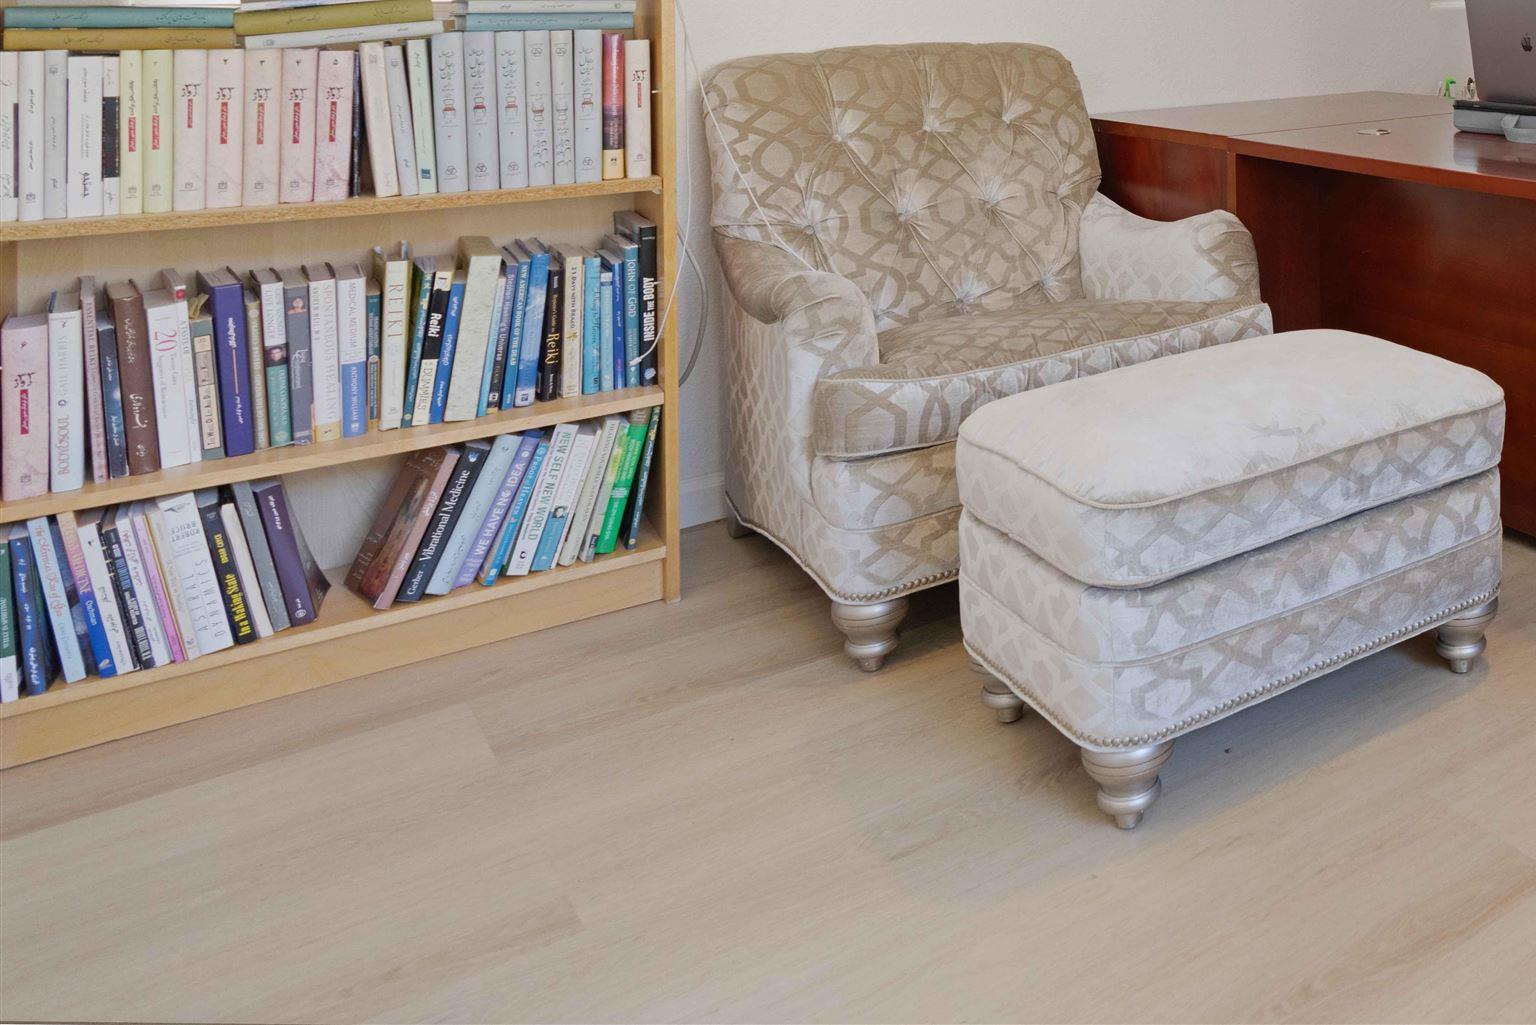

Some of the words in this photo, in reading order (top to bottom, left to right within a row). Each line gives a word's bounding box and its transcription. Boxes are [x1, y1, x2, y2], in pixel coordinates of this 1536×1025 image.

[501, 273, 515, 300] Stephen
[643, 277, 655, 299] BODY
[387, 283, 404, 339] REIKI
[498, 301, 511, 333] Hawking's
[627, 297, 637, 318] GOD
[428, 312, 440, 338] Reiki
[643, 309, 655, 341] INSIDE
[153, 330, 178, 352] 20
[495, 333, 507, 361] Universe
[556, 429, 573, 454] NEW
[547, 452, 565, 481] SELF
[540, 479, 556, 504] NEW
[473, 537, 491, 557] WE
[483, 507, 506, 538] HAVE
[505, 461, 526, 488] IDEA
[527, 503, 548, 542] WORLD
[406, 568, 425, 597] Gerber
[419, 511, 452, 565] Vibrational
[442, 468, 472, 514] Medicine
